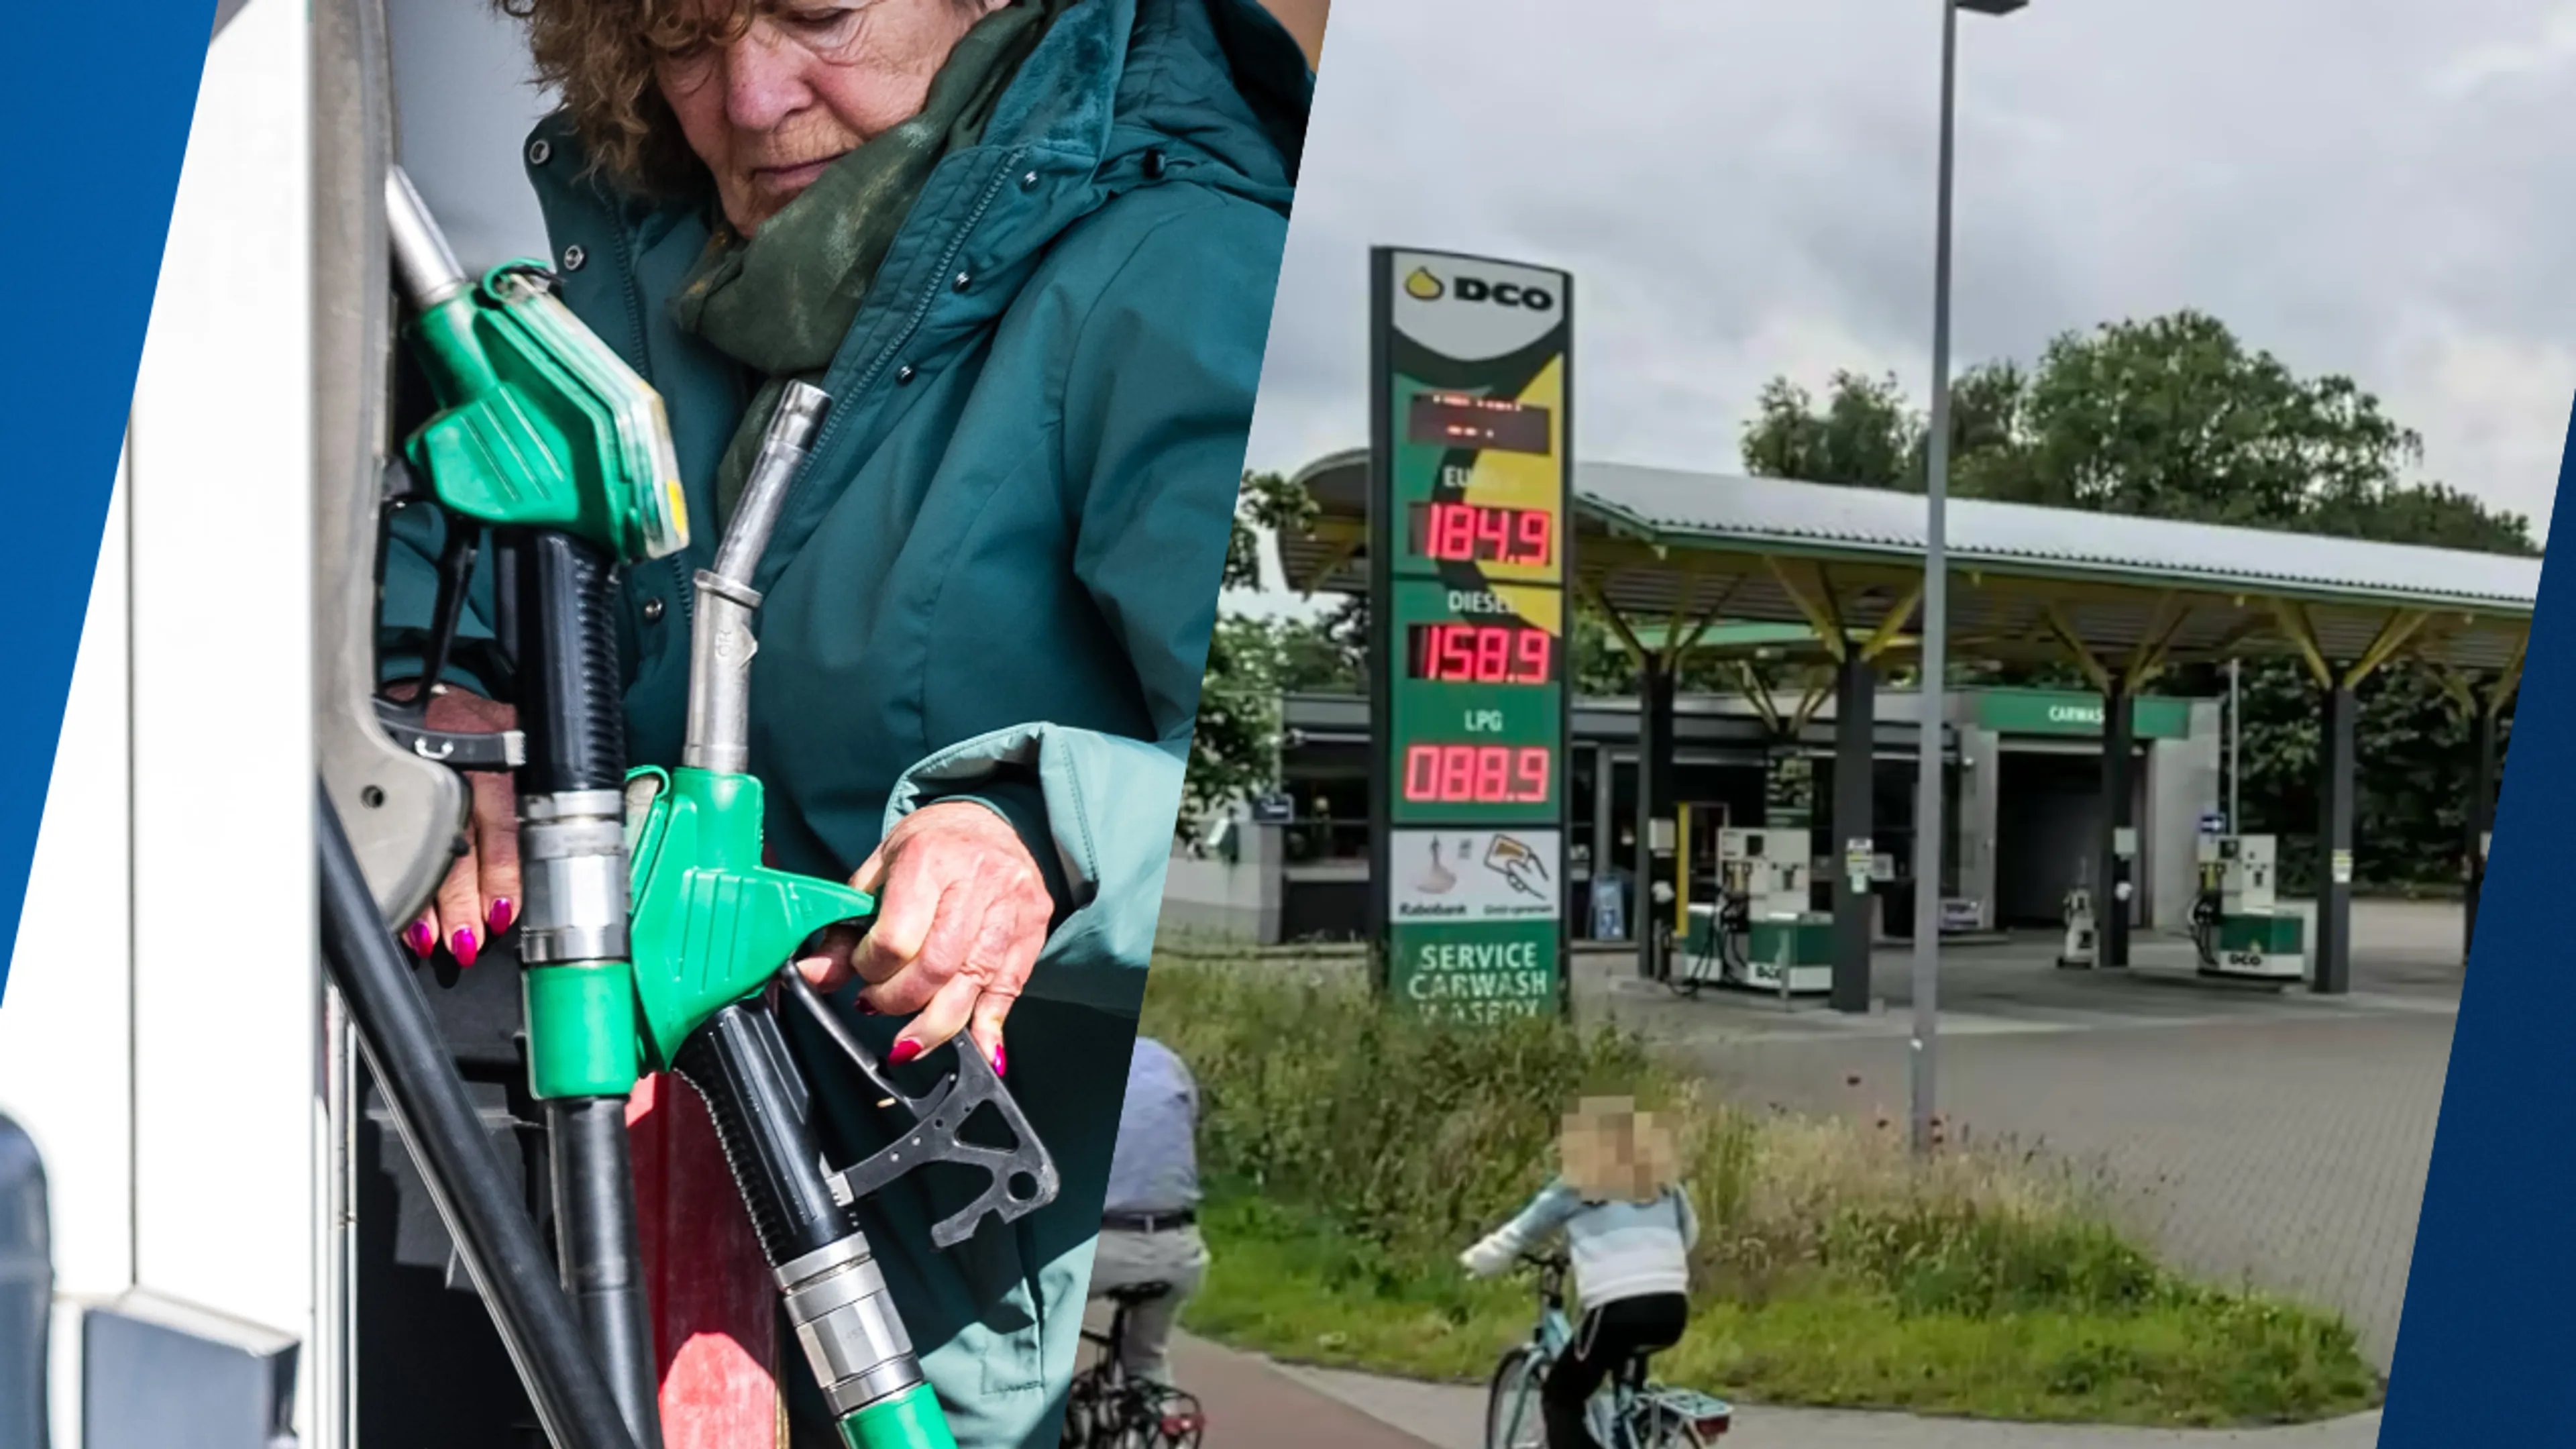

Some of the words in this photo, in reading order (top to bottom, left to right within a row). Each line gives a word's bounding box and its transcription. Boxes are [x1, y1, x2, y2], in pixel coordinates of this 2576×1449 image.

[1454, 276, 1553, 311] DCO
[1426, 502, 1550, 567] 184.9
[1427, 625, 1549, 685] 158.9
[1464, 710, 1503, 731] LPG
[2049, 704, 2105, 724] CARWAS
[1404, 744, 1549, 802] 088.9
[1420, 943, 1537, 971] SERVICE
[1408, 970, 1547, 1000] CARWASH
